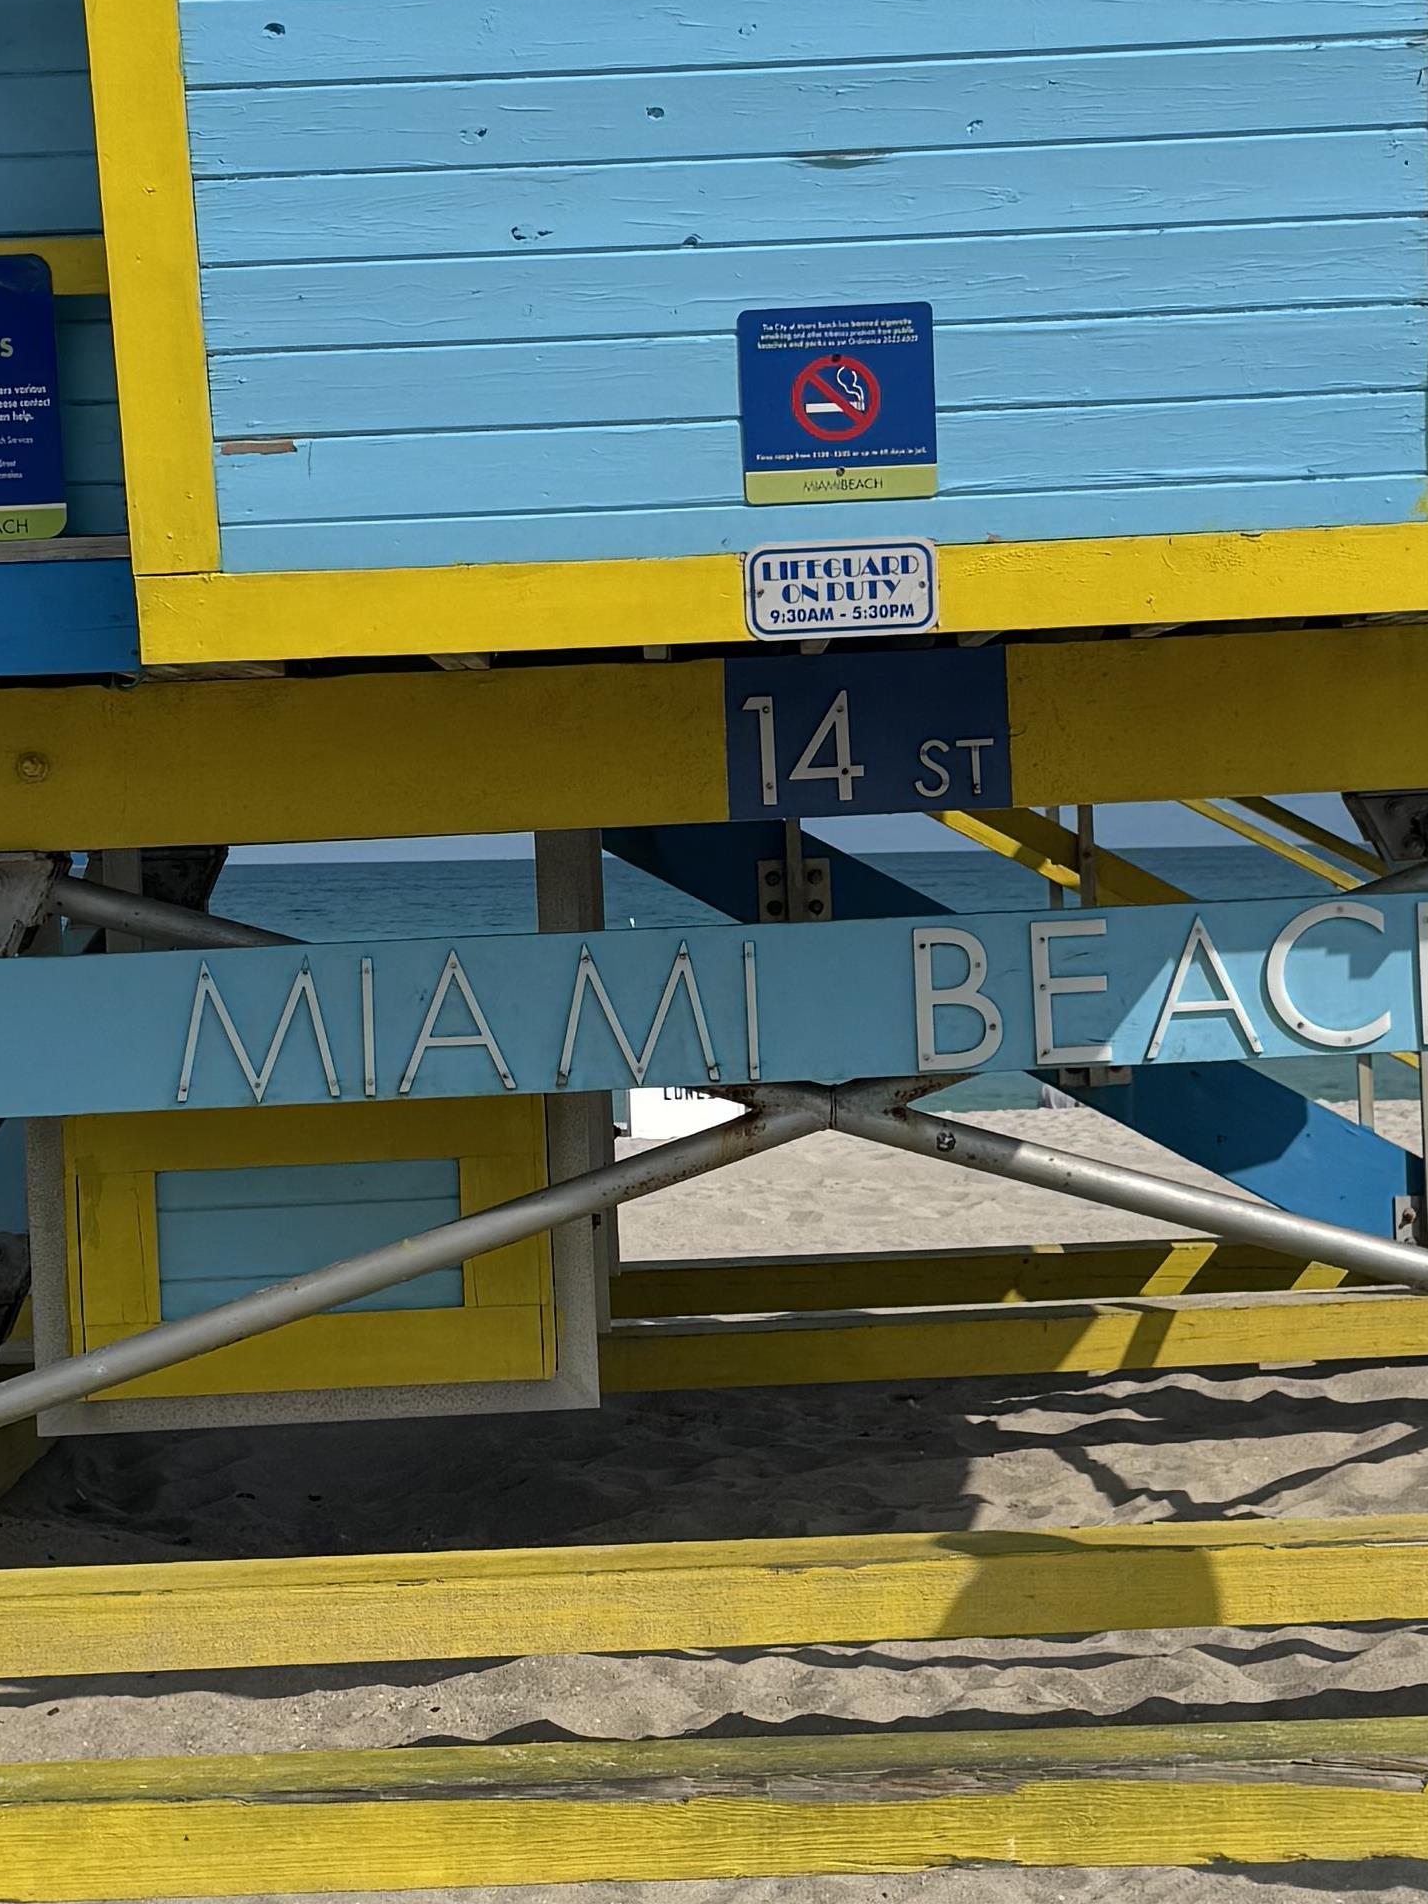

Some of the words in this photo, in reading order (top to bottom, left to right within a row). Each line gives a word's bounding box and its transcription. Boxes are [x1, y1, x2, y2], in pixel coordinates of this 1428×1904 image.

[14, 385, 47, 394] various
[20, 397, 50, 407] contact
[762, 555, 919, 581] LIFEGUARD
[782, 583, 819, 604] ON
[827, 579, 901, 601] DUTY
[771, 607, 834, 624] 9:30AM
[853, 604, 914, 619] 5:30PM
[742, 689, 864, 805] 14
[914, 738, 994, 797] ST
[177, 937, 763, 1102] MIAMI
